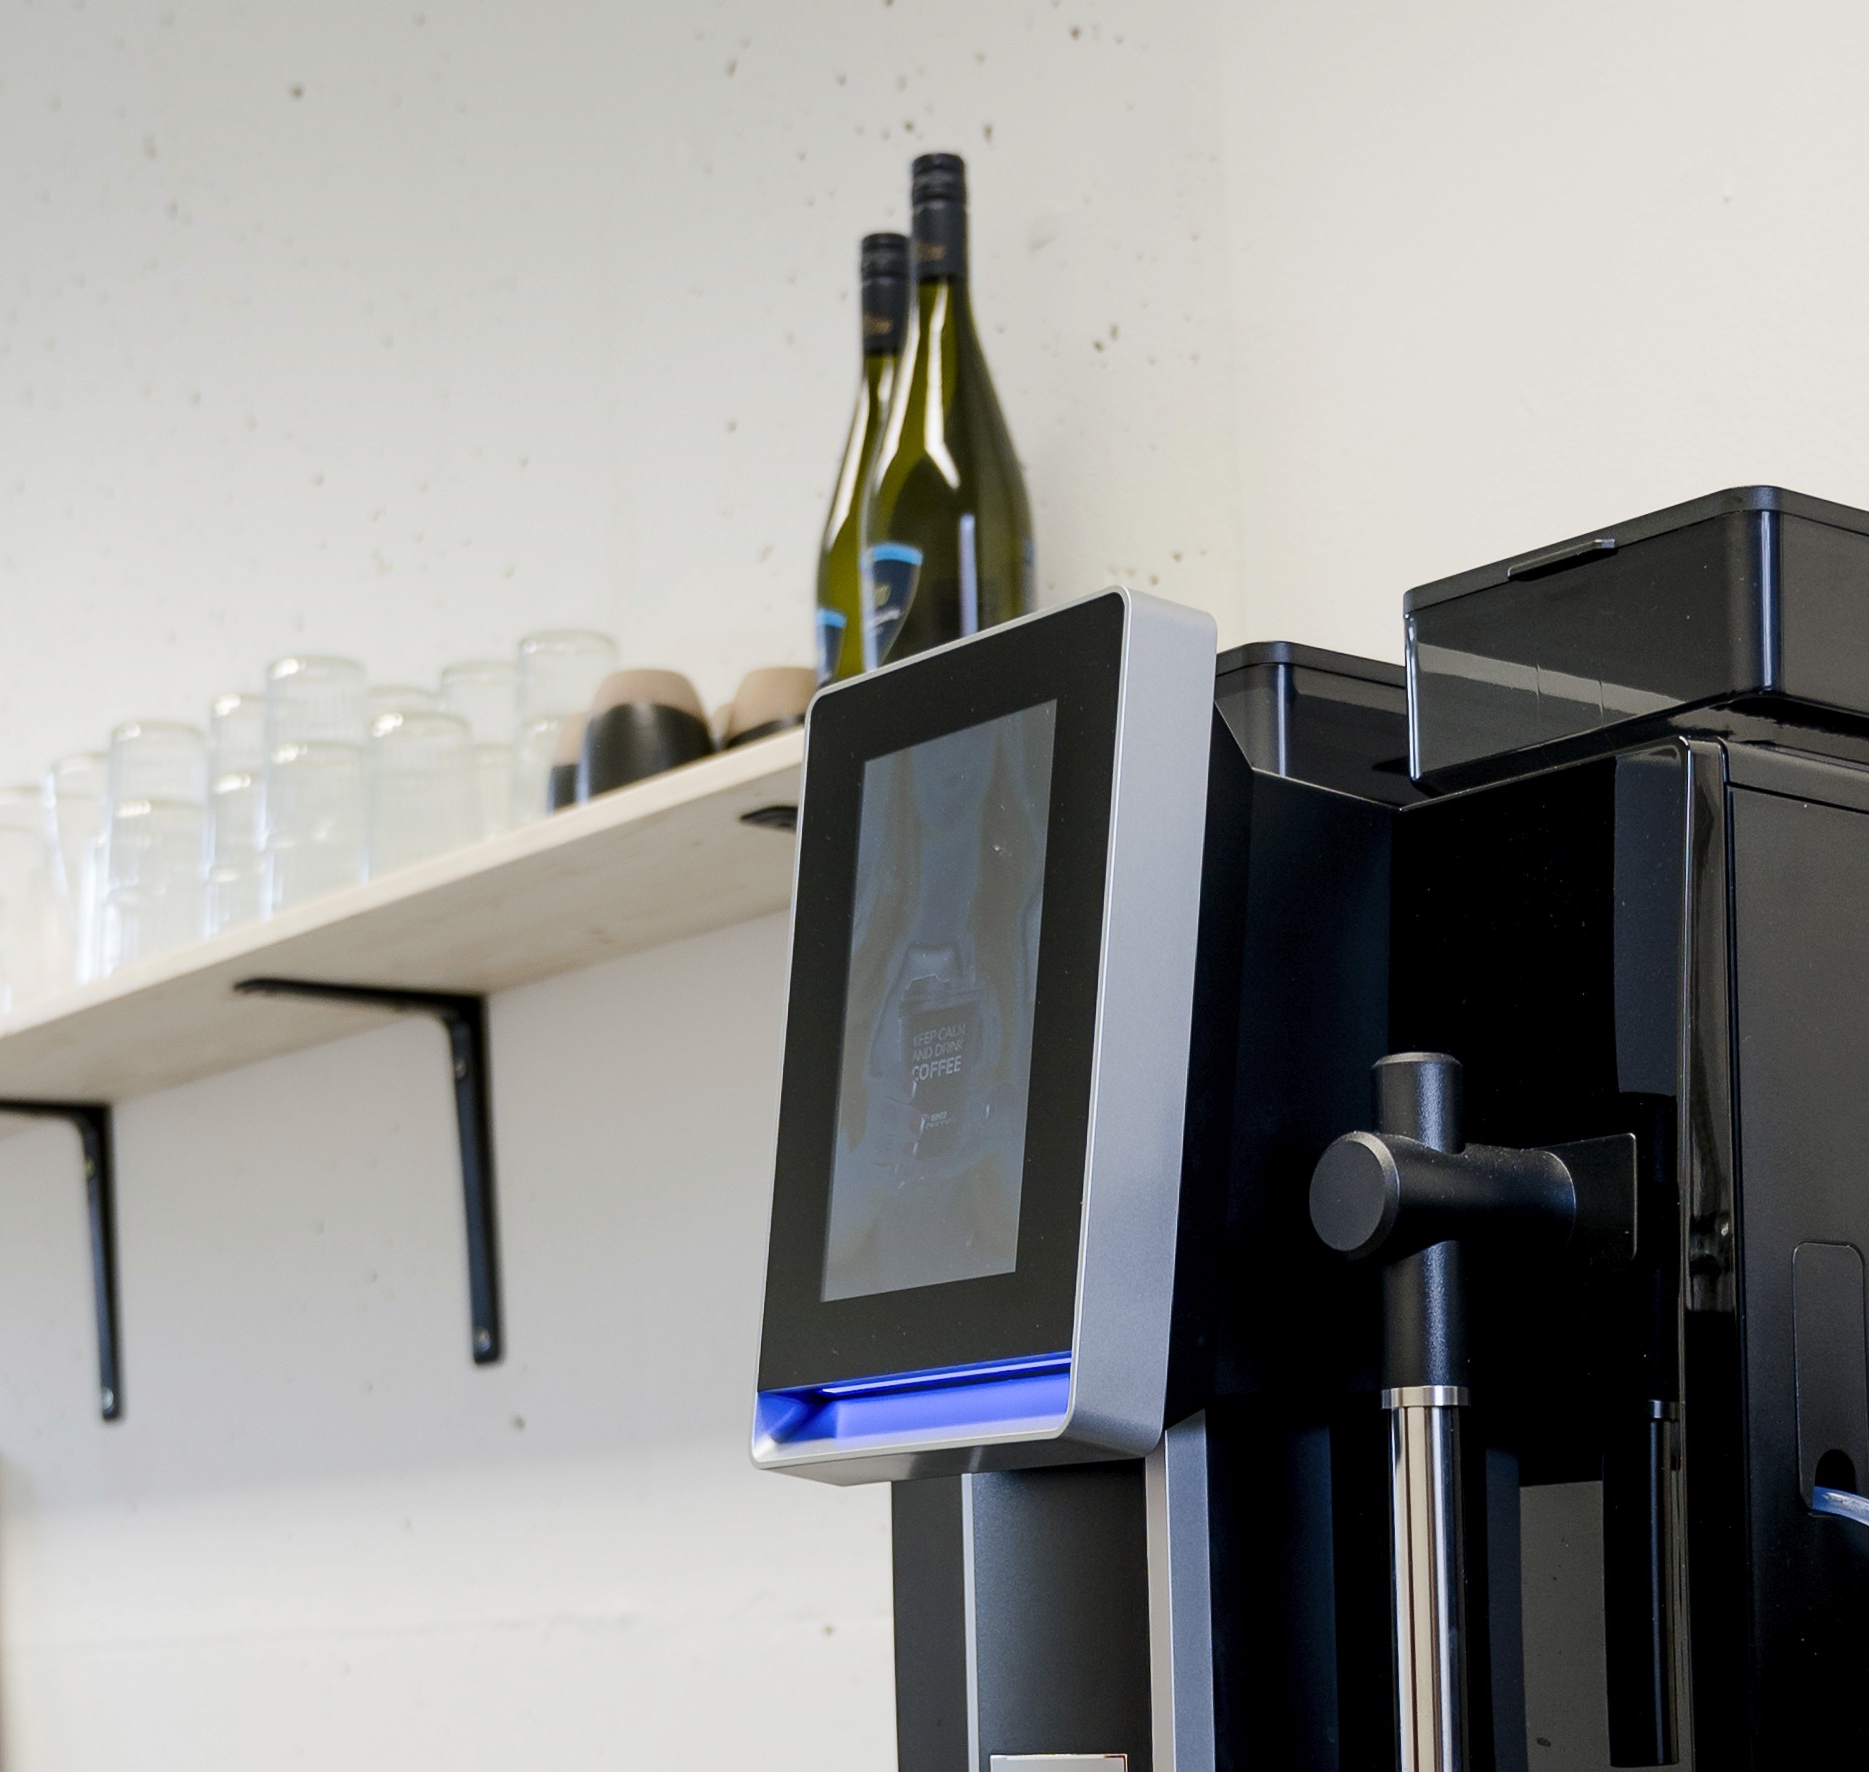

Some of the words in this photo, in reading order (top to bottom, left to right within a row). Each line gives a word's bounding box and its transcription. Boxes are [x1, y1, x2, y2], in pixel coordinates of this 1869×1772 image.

[913, 1030, 937, 1048] KEEP
[938, 1023, 966, 1041] CALM
[913, 1046, 933, 1061] AND
[935, 1039, 964, 1057] DRINK
[912, 1055, 962, 1081] COFFEE
